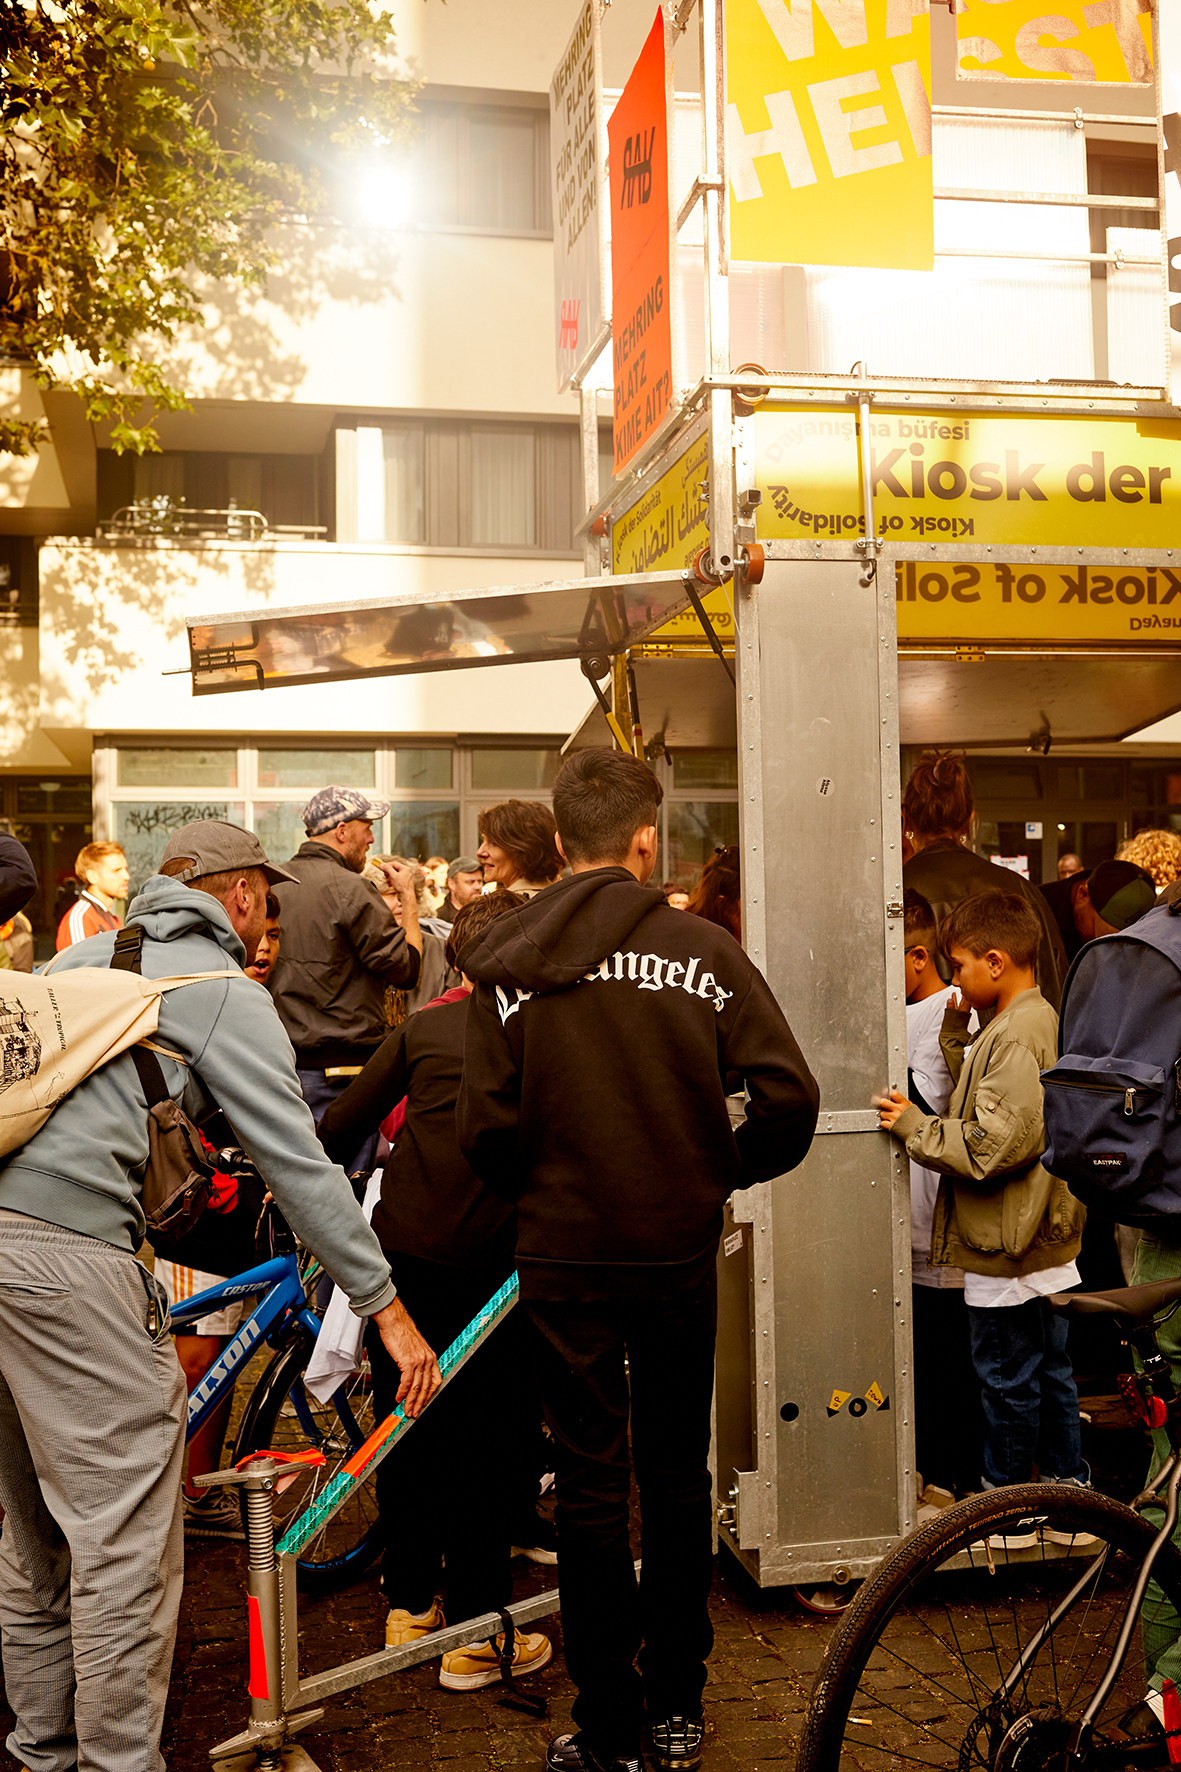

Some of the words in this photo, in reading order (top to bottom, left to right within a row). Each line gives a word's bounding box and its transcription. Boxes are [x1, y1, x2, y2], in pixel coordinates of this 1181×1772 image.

[553, 3, 592, 112] MEHRING
[566, 44, 594, 126] PLATZ
[556, 139, 573, 193] FÜR
[574, 88, 595, 158] ALLE
[559, 175, 576, 227] UND
[577, 132, 596, 189] VON
[567, 176, 597, 256] ALLEN!
[614, 275, 664, 375] MEHRING
[615, 348, 648, 420] PLATZ
[615, 408, 642, 466] KIME
[644, 370, 670, 432] AIT?
[898, 419, 970, 441] büfesi
[872, 442, 1049, 501] Kiosk
[1065, 451, 1172, 504] der
[879, 515, 904, 535] of
[910, 516, 975, 538] Kiosk
[221, 1280, 271, 1297] CASTOR
[931, 1528, 967, 1556] vittoria
[968, 1511, 1004, 1531] TERRENO
[1004, 1506, 1027, 1517] ZERO
